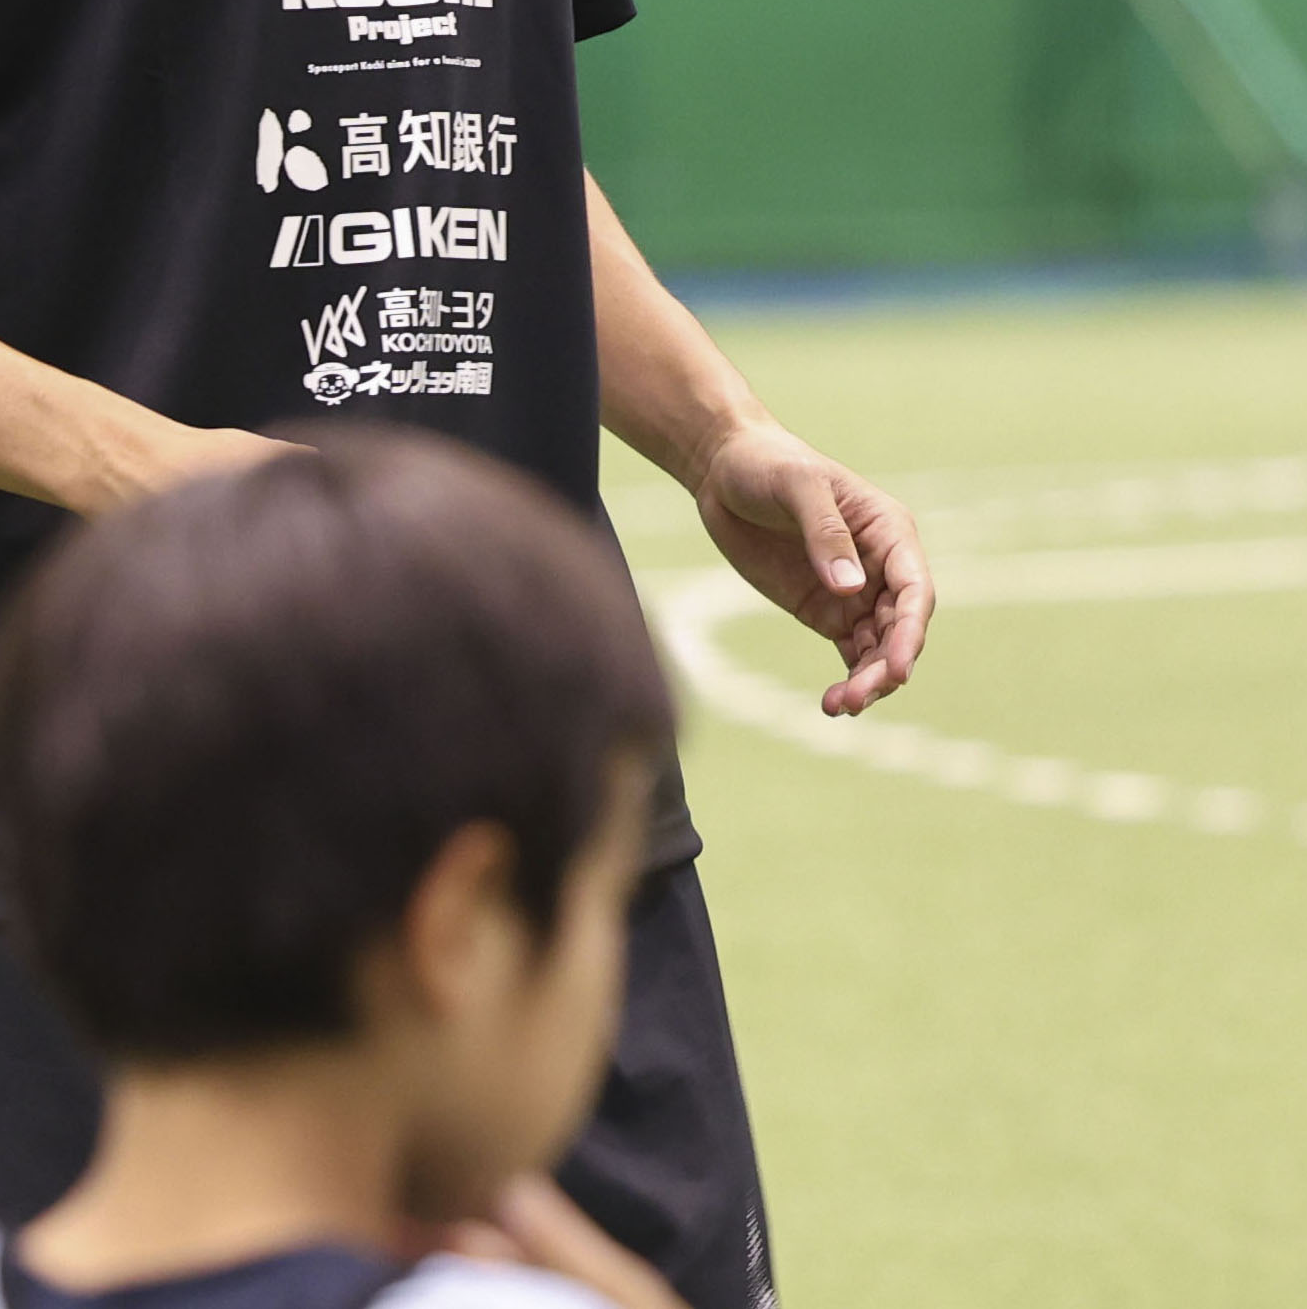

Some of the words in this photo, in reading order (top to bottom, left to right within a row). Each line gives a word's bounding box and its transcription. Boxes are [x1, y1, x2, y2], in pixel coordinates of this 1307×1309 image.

[347, 11, 458, 45] Project
[412, 56, 431, 67] for
[339, 109, 518, 180] 高知銀行
[328, 205, 508, 265] GIKEN
